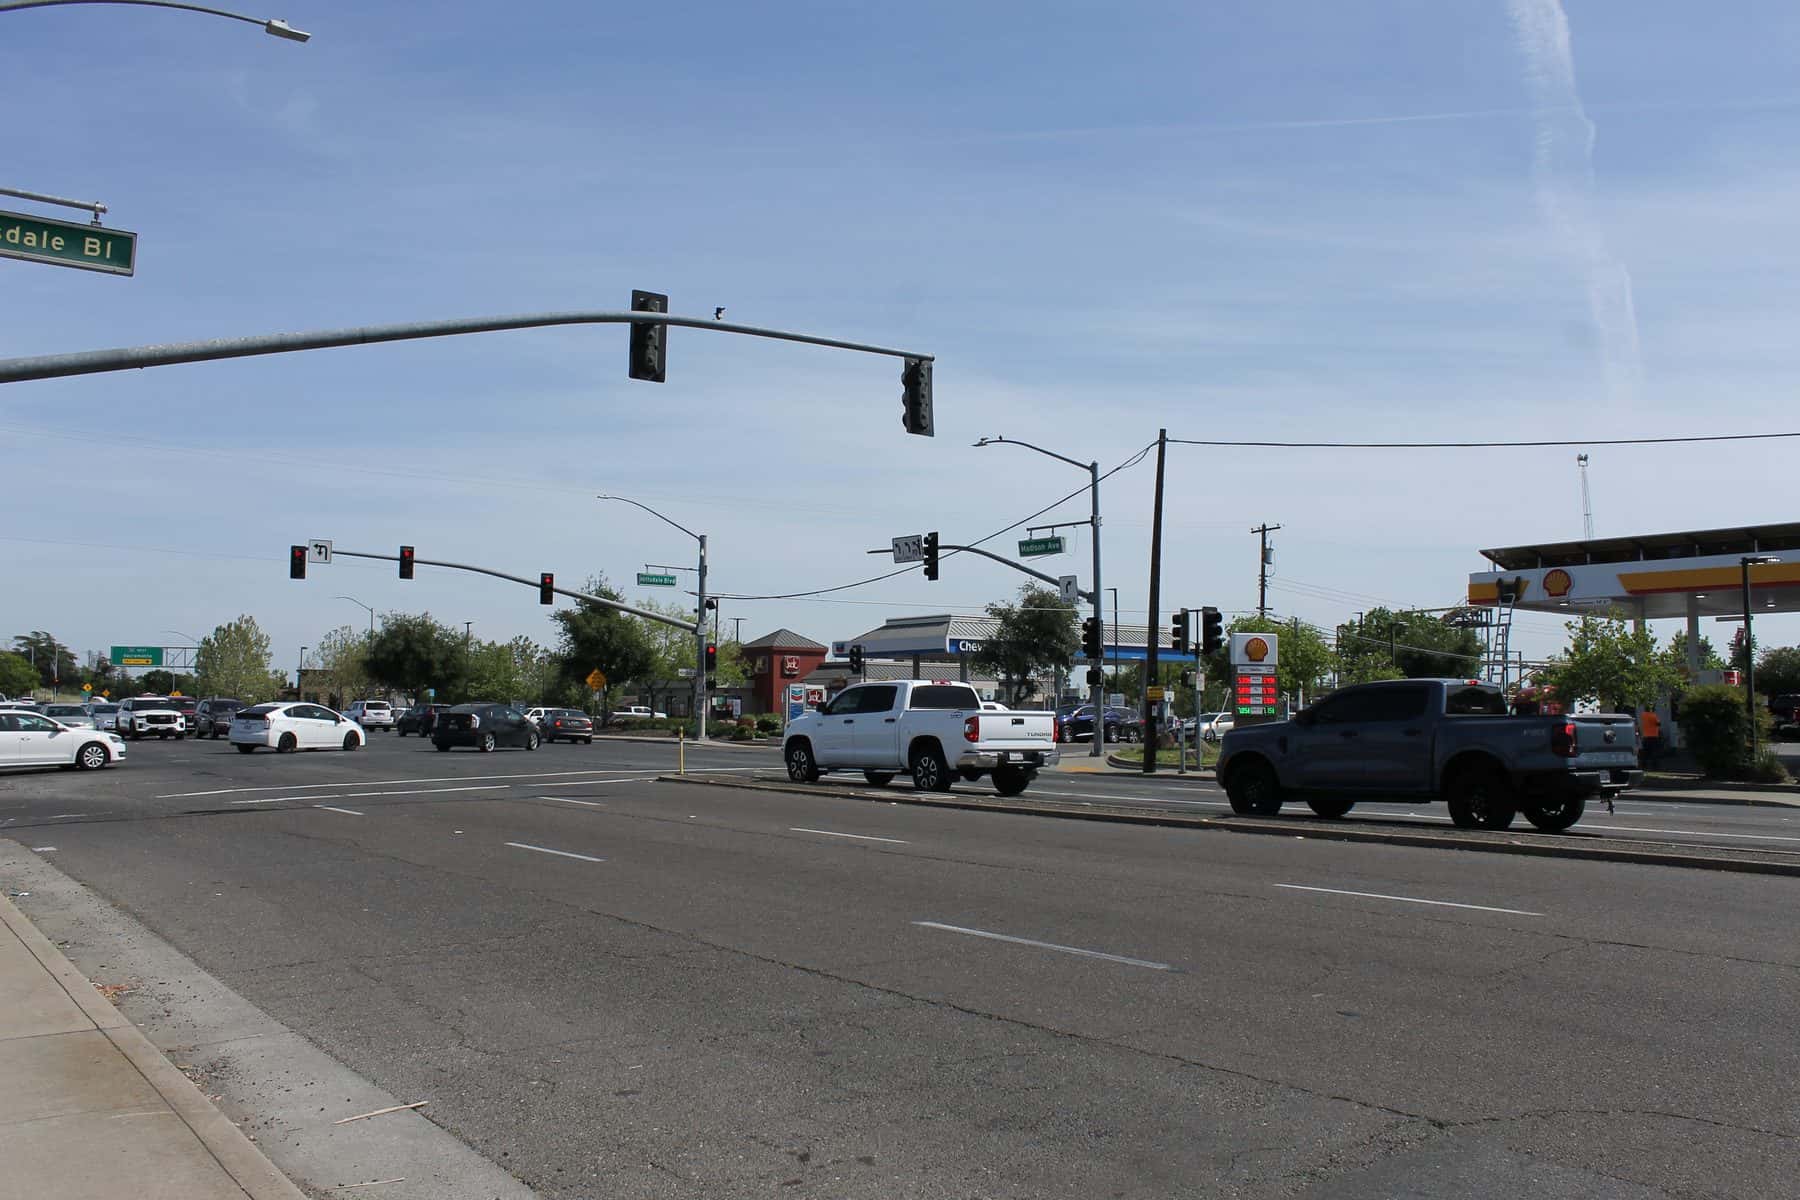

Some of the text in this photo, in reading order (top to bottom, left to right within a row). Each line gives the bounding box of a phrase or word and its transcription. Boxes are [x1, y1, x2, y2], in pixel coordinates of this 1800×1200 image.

[0, 226, 65, 250] dale
[1047, 541, 1060, 550] Ave
[959, 640, 983, 652] Chev
